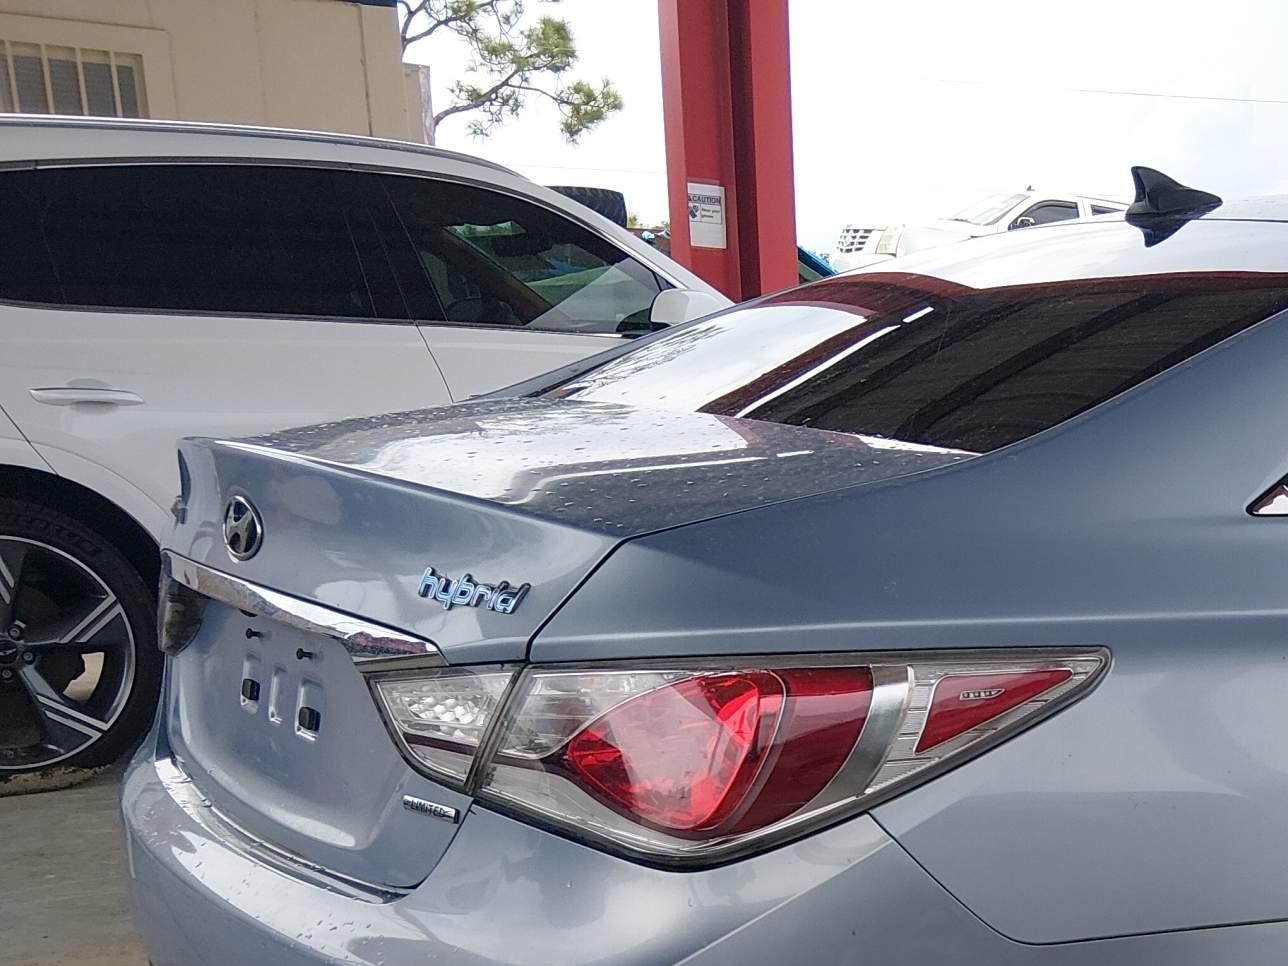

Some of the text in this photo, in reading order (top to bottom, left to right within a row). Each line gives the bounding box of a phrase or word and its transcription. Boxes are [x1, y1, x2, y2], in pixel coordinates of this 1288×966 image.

[692, 195, 721, 204] CAUTION
[418, 567, 532, 614] hybrid
[411, 800, 445, 817] LIMITED
